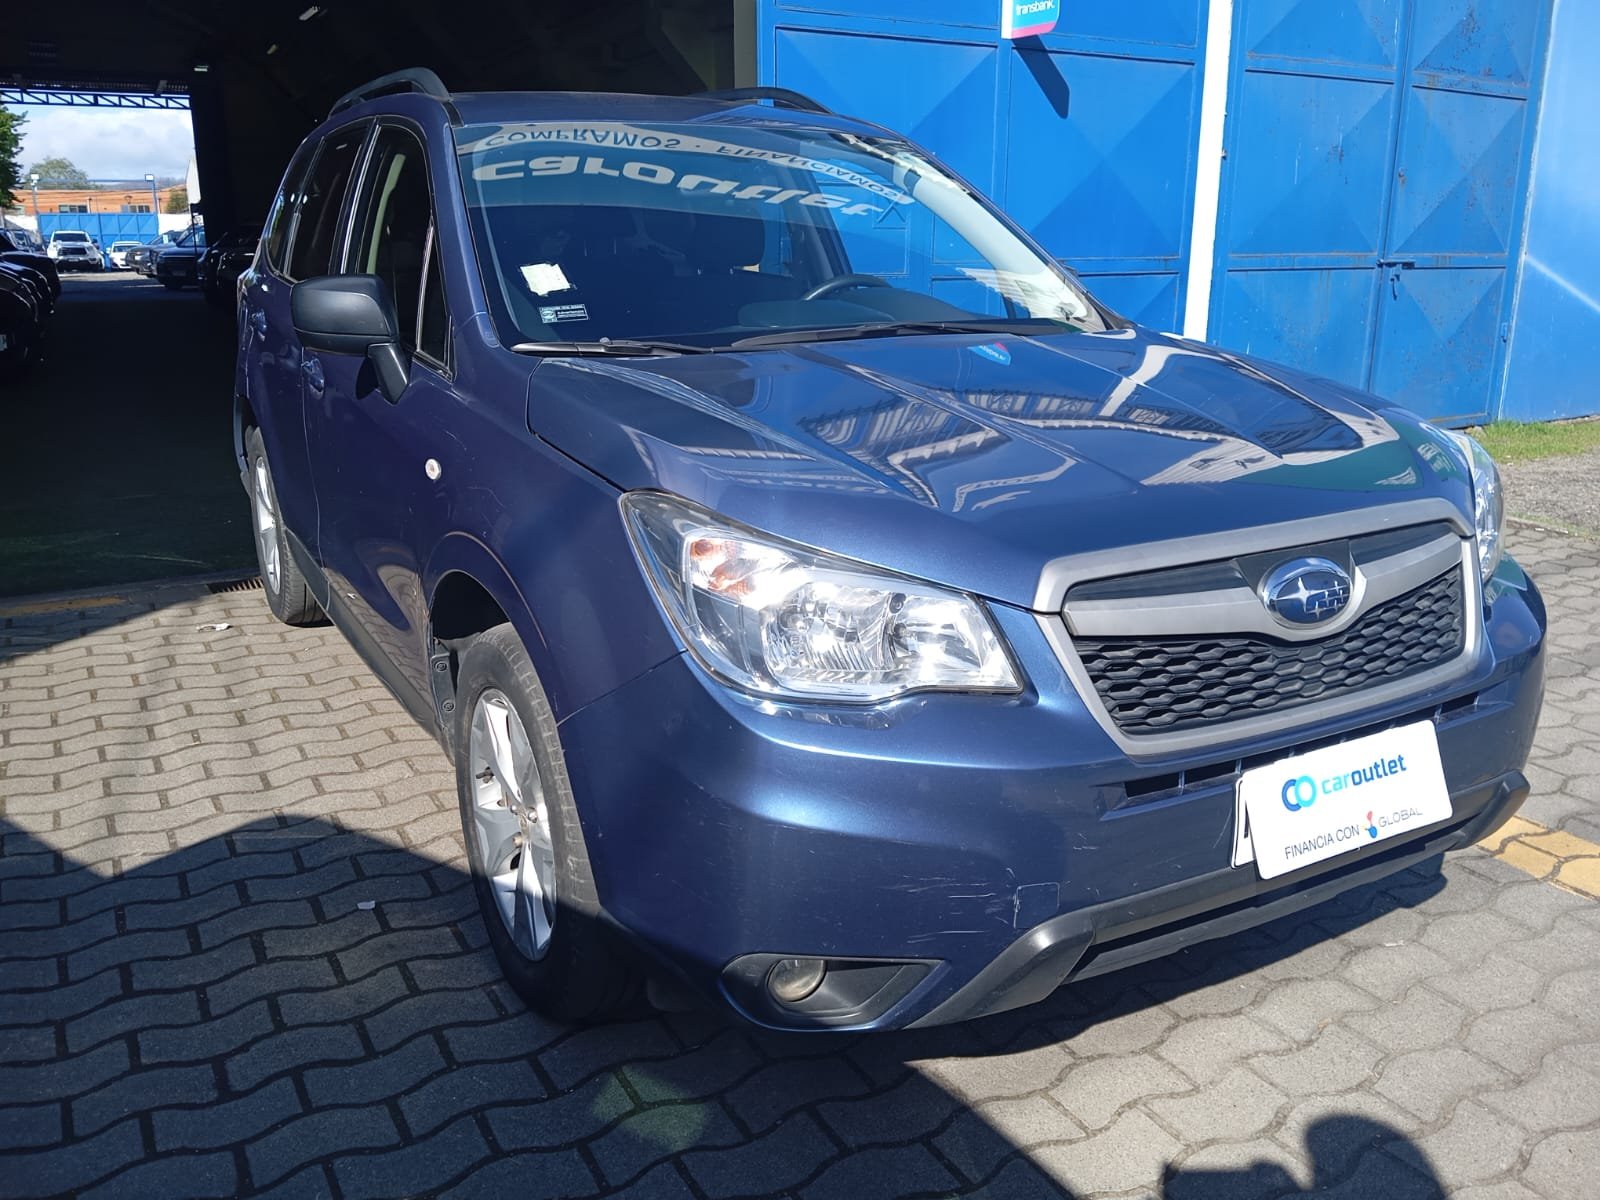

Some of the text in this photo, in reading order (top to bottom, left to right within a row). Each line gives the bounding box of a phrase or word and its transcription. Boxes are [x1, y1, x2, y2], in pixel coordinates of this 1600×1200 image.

[1321, 754, 1407, 795] caroutlet
[1284, 807, 1423, 859] FINANCIA CON GLOBAL
